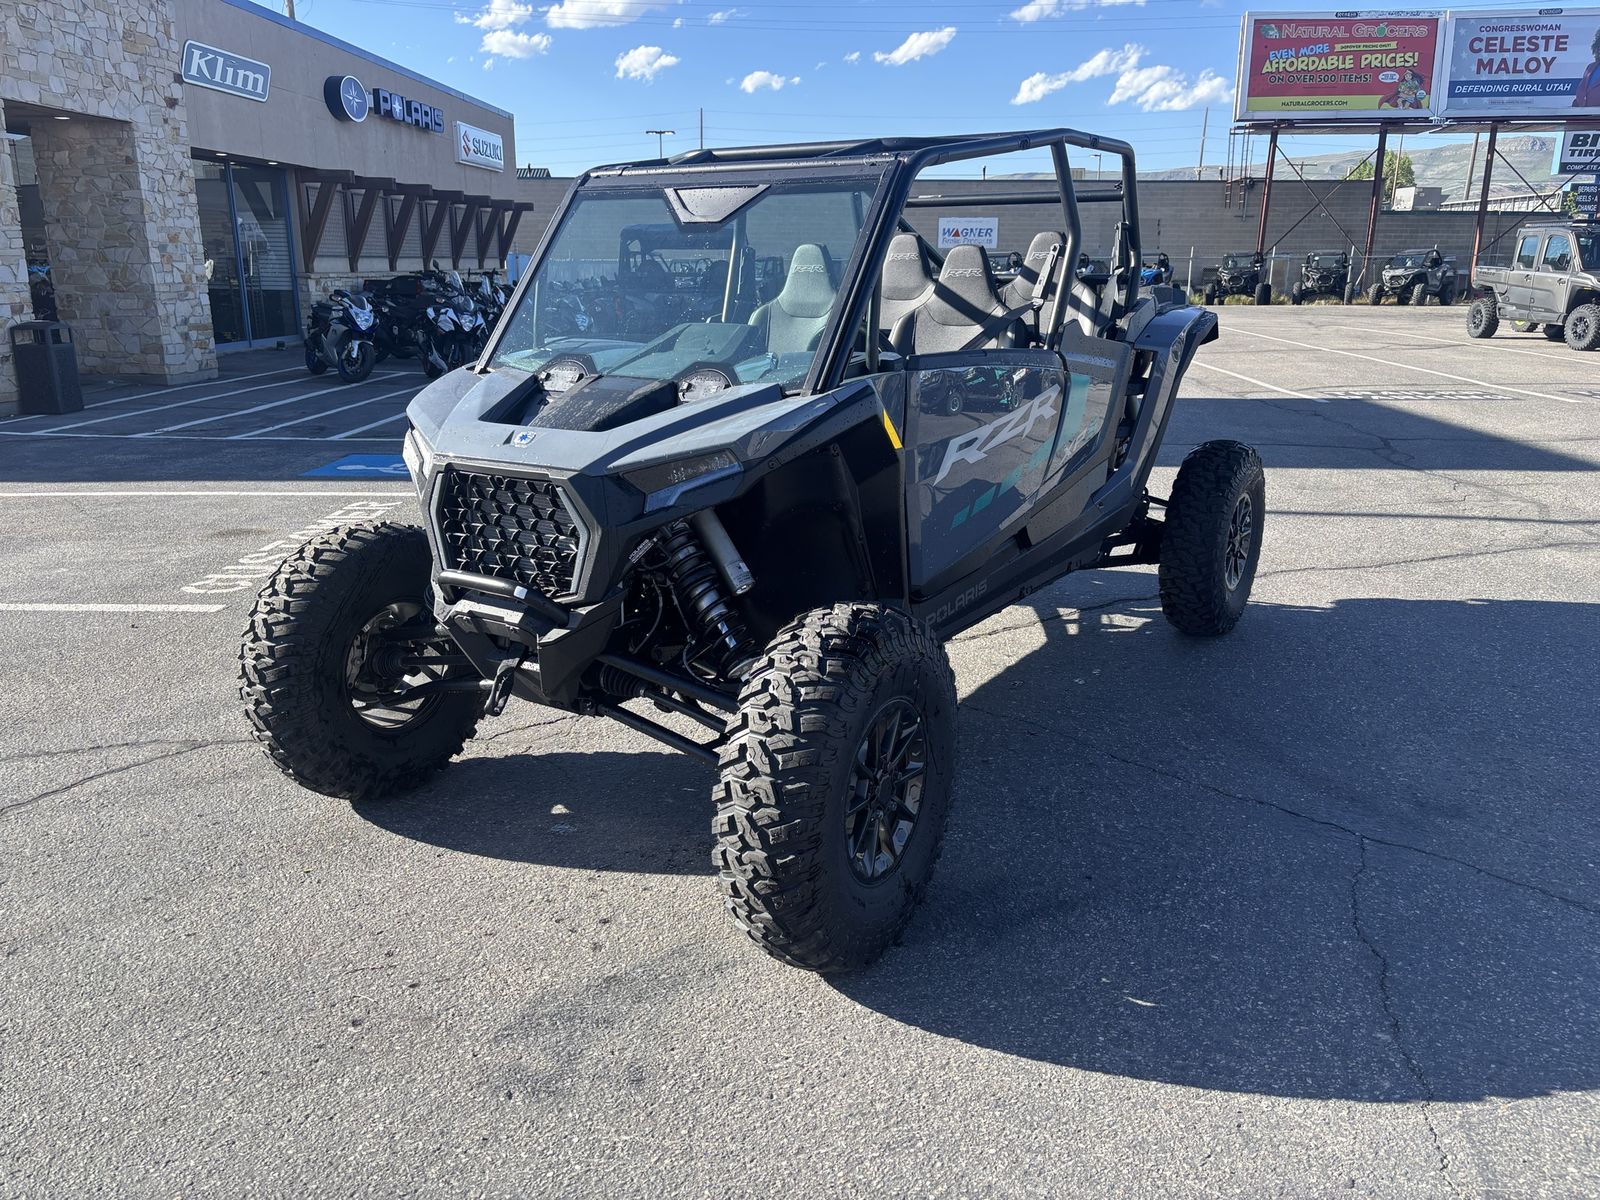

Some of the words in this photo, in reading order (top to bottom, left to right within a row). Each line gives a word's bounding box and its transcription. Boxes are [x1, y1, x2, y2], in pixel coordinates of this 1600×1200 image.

[1281, 23, 1349, 38] NATURAL
[1352, 22, 1428, 38] GROCERS
[1479, 24, 1562, 33] CONGRESSWOMAN
[1269, 49, 1296, 62] EVEN
[1298, 43, 1330, 57] MORE
[1468, 34, 1569, 54] CELESTE
[188, 48, 265, 95] Klim
[1261, 55, 1354, 74] AFFORDABLE
[1360, 52, 1419, 69] PRICES!
[1475, 56, 1557, 75] MALOY
[1269, 74, 1285, 84] ON
[1287, 74, 1316, 84] OVER
[1317, 74, 1337, 83] 500
[1339, 73, 1373, 83] ITEMS!
[1454, 84, 1510, 94] DEFENDING
[1511, 84, 1543, 93] RURAL
[1545, 83, 1572, 92] UTAH
[375, 88, 445, 133] POLARIS
[472, 137, 502, 161] SUZUKI
[942, 227, 993, 238] WAGNER
[793, 264, 824, 273] RZR
[945, 268, 983, 278] RZR
[934, 383, 1061, 488] RZR
[925, 578, 988, 628] POLARIS
